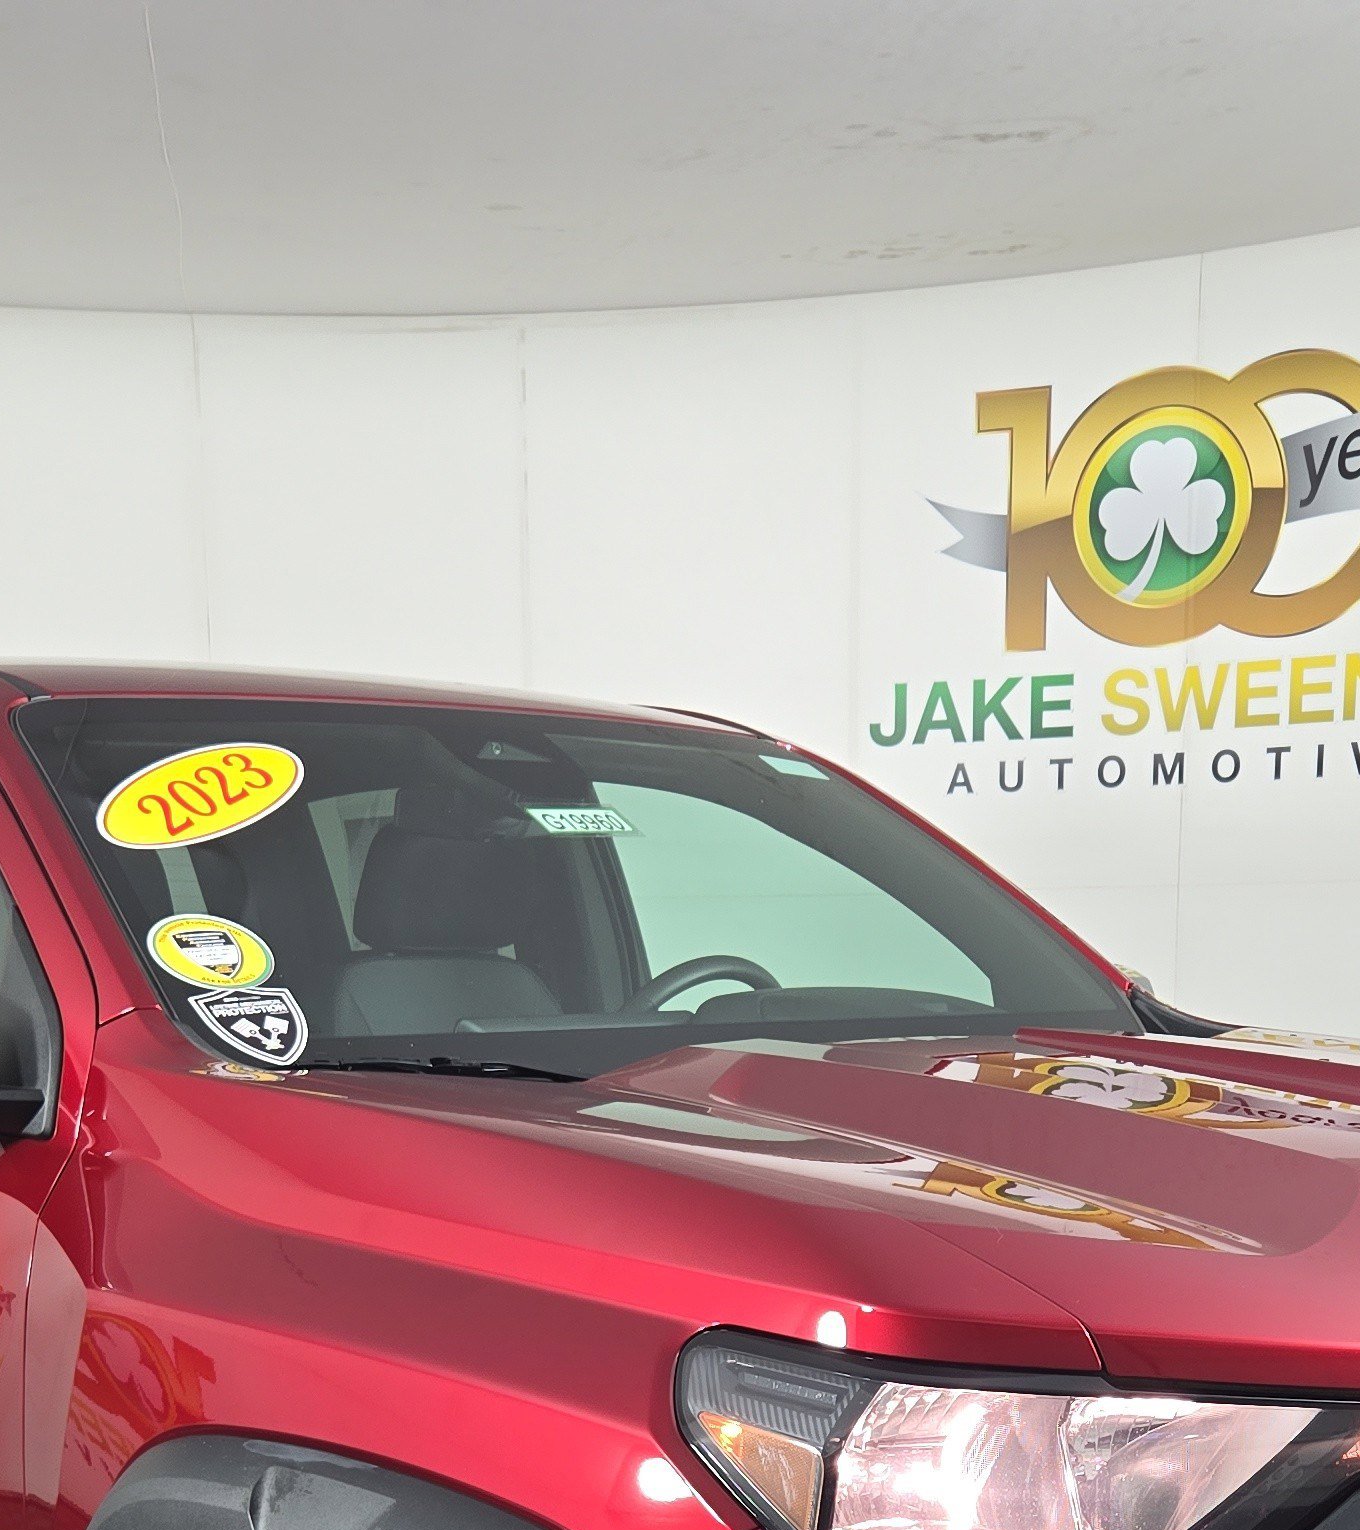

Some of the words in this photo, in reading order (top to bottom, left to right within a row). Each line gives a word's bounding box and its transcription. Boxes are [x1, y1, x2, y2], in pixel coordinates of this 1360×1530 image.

[869, 674, 1076, 747] JAKE
[137, 753, 274, 836] 2023
[541, 813, 625, 831] G19960
